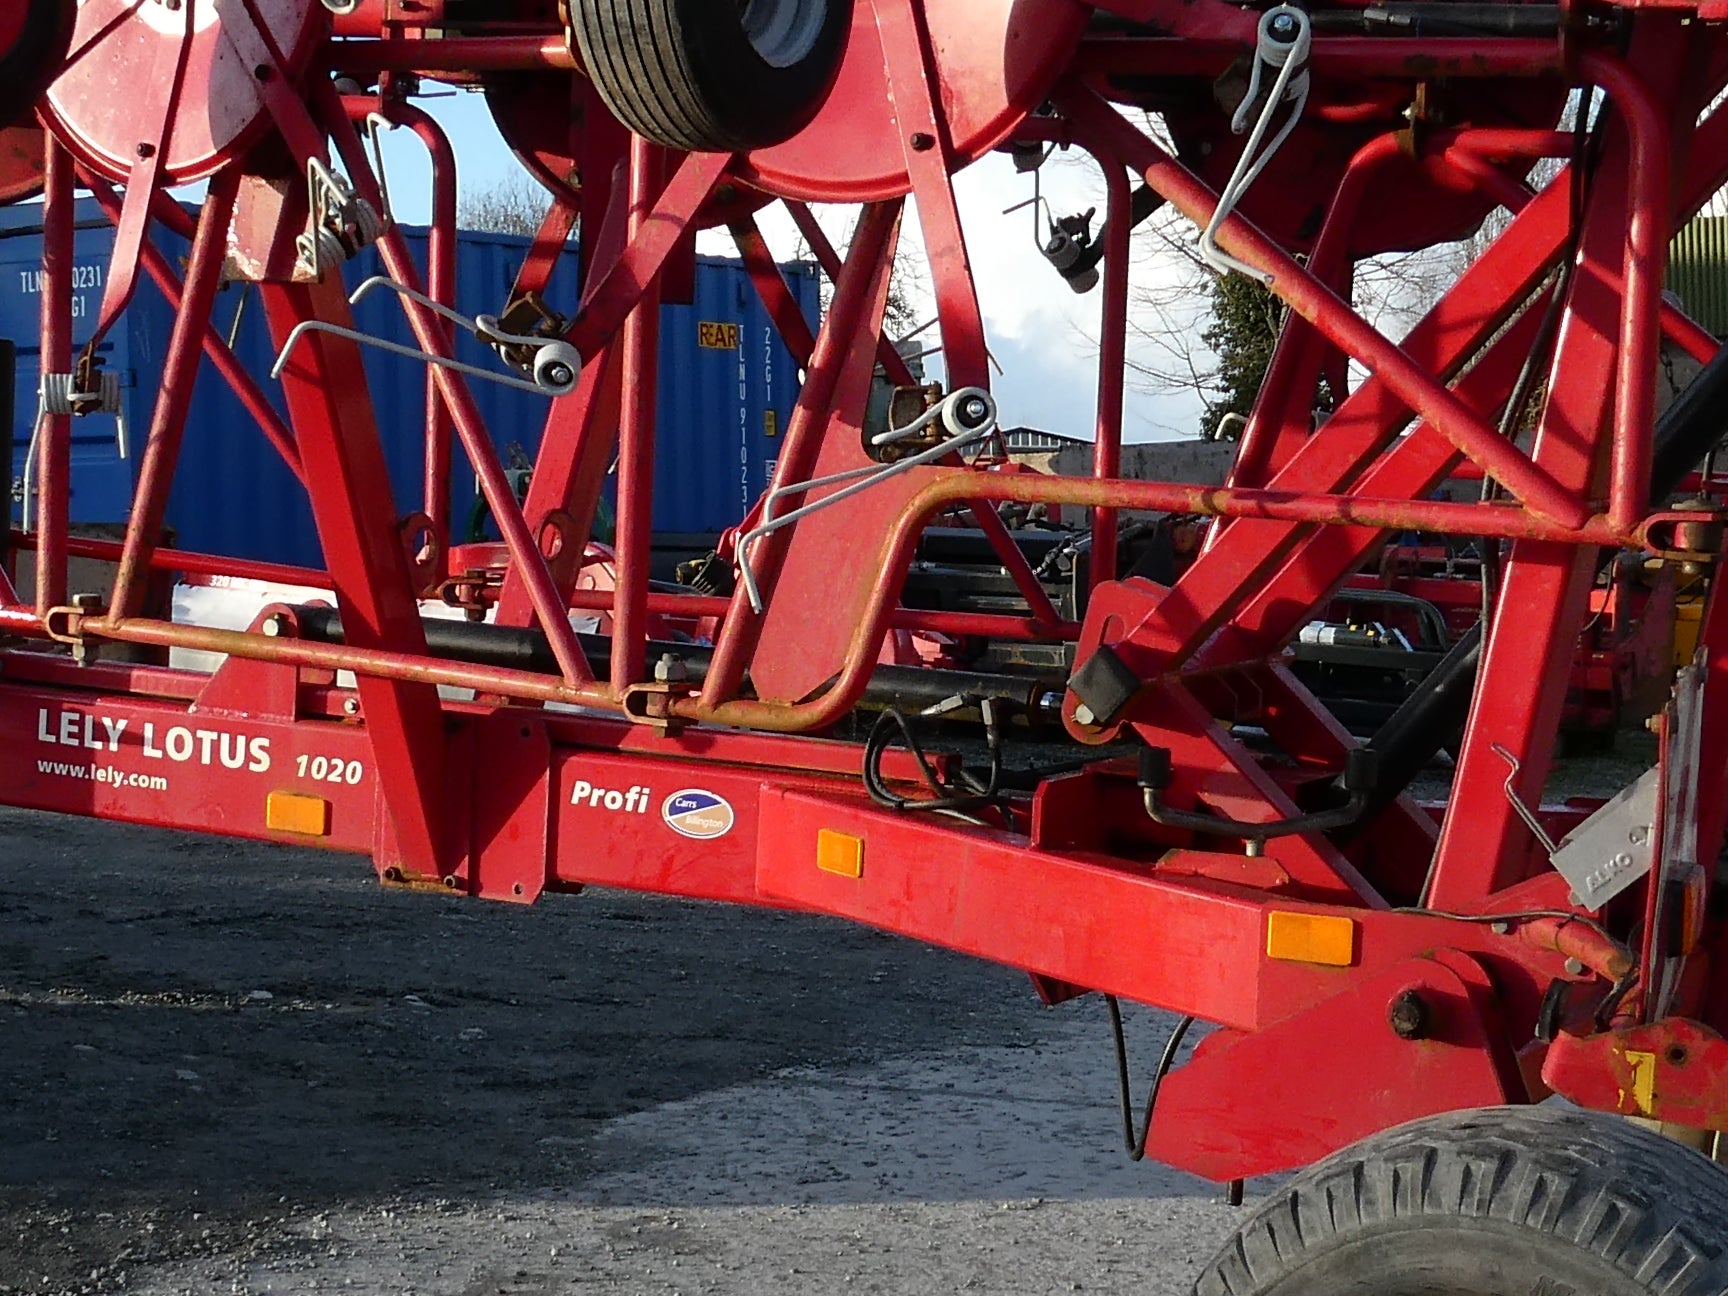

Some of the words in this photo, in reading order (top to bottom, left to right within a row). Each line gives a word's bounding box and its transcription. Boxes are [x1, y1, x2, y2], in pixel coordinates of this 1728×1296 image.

[21, 270, 44, 293] TLN
[72, 266, 101, 289] 0231
[699, 324, 736, 347] REAR
[38, 708, 128, 752] LELY
[143, 723, 271, 773] LOTUS
[296, 754, 363, 785] 1020
[37, 759, 168, 791] www.lely.com
[570, 780, 651, 814] Profi
[675, 797, 697, 809] Carrs
[685, 814, 724, 828] Billington
